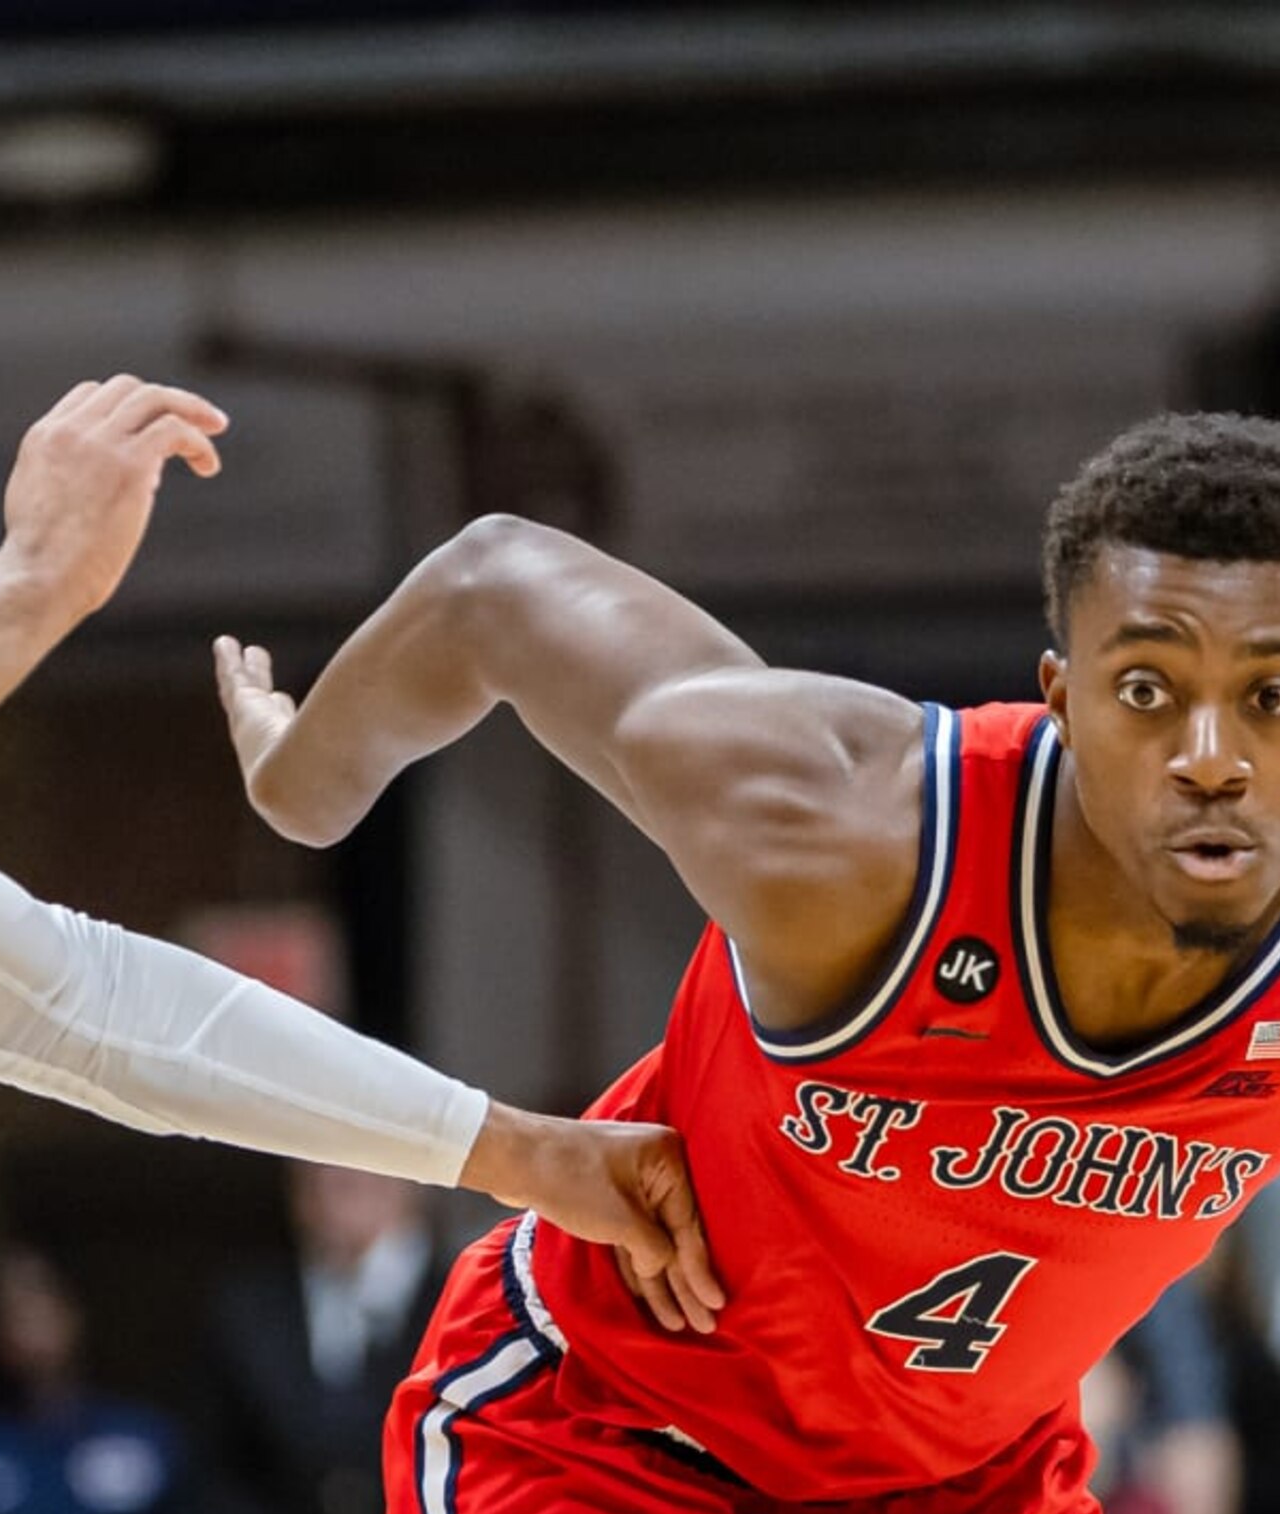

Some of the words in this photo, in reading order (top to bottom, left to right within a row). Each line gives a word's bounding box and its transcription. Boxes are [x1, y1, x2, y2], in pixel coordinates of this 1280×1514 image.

[940, 949, 994, 992] JK
[780, 1080, 926, 1181] ST.
[930, 1106, 1271, 1220] JOHN'S
[864, 1250, 1038, 1373] 4
